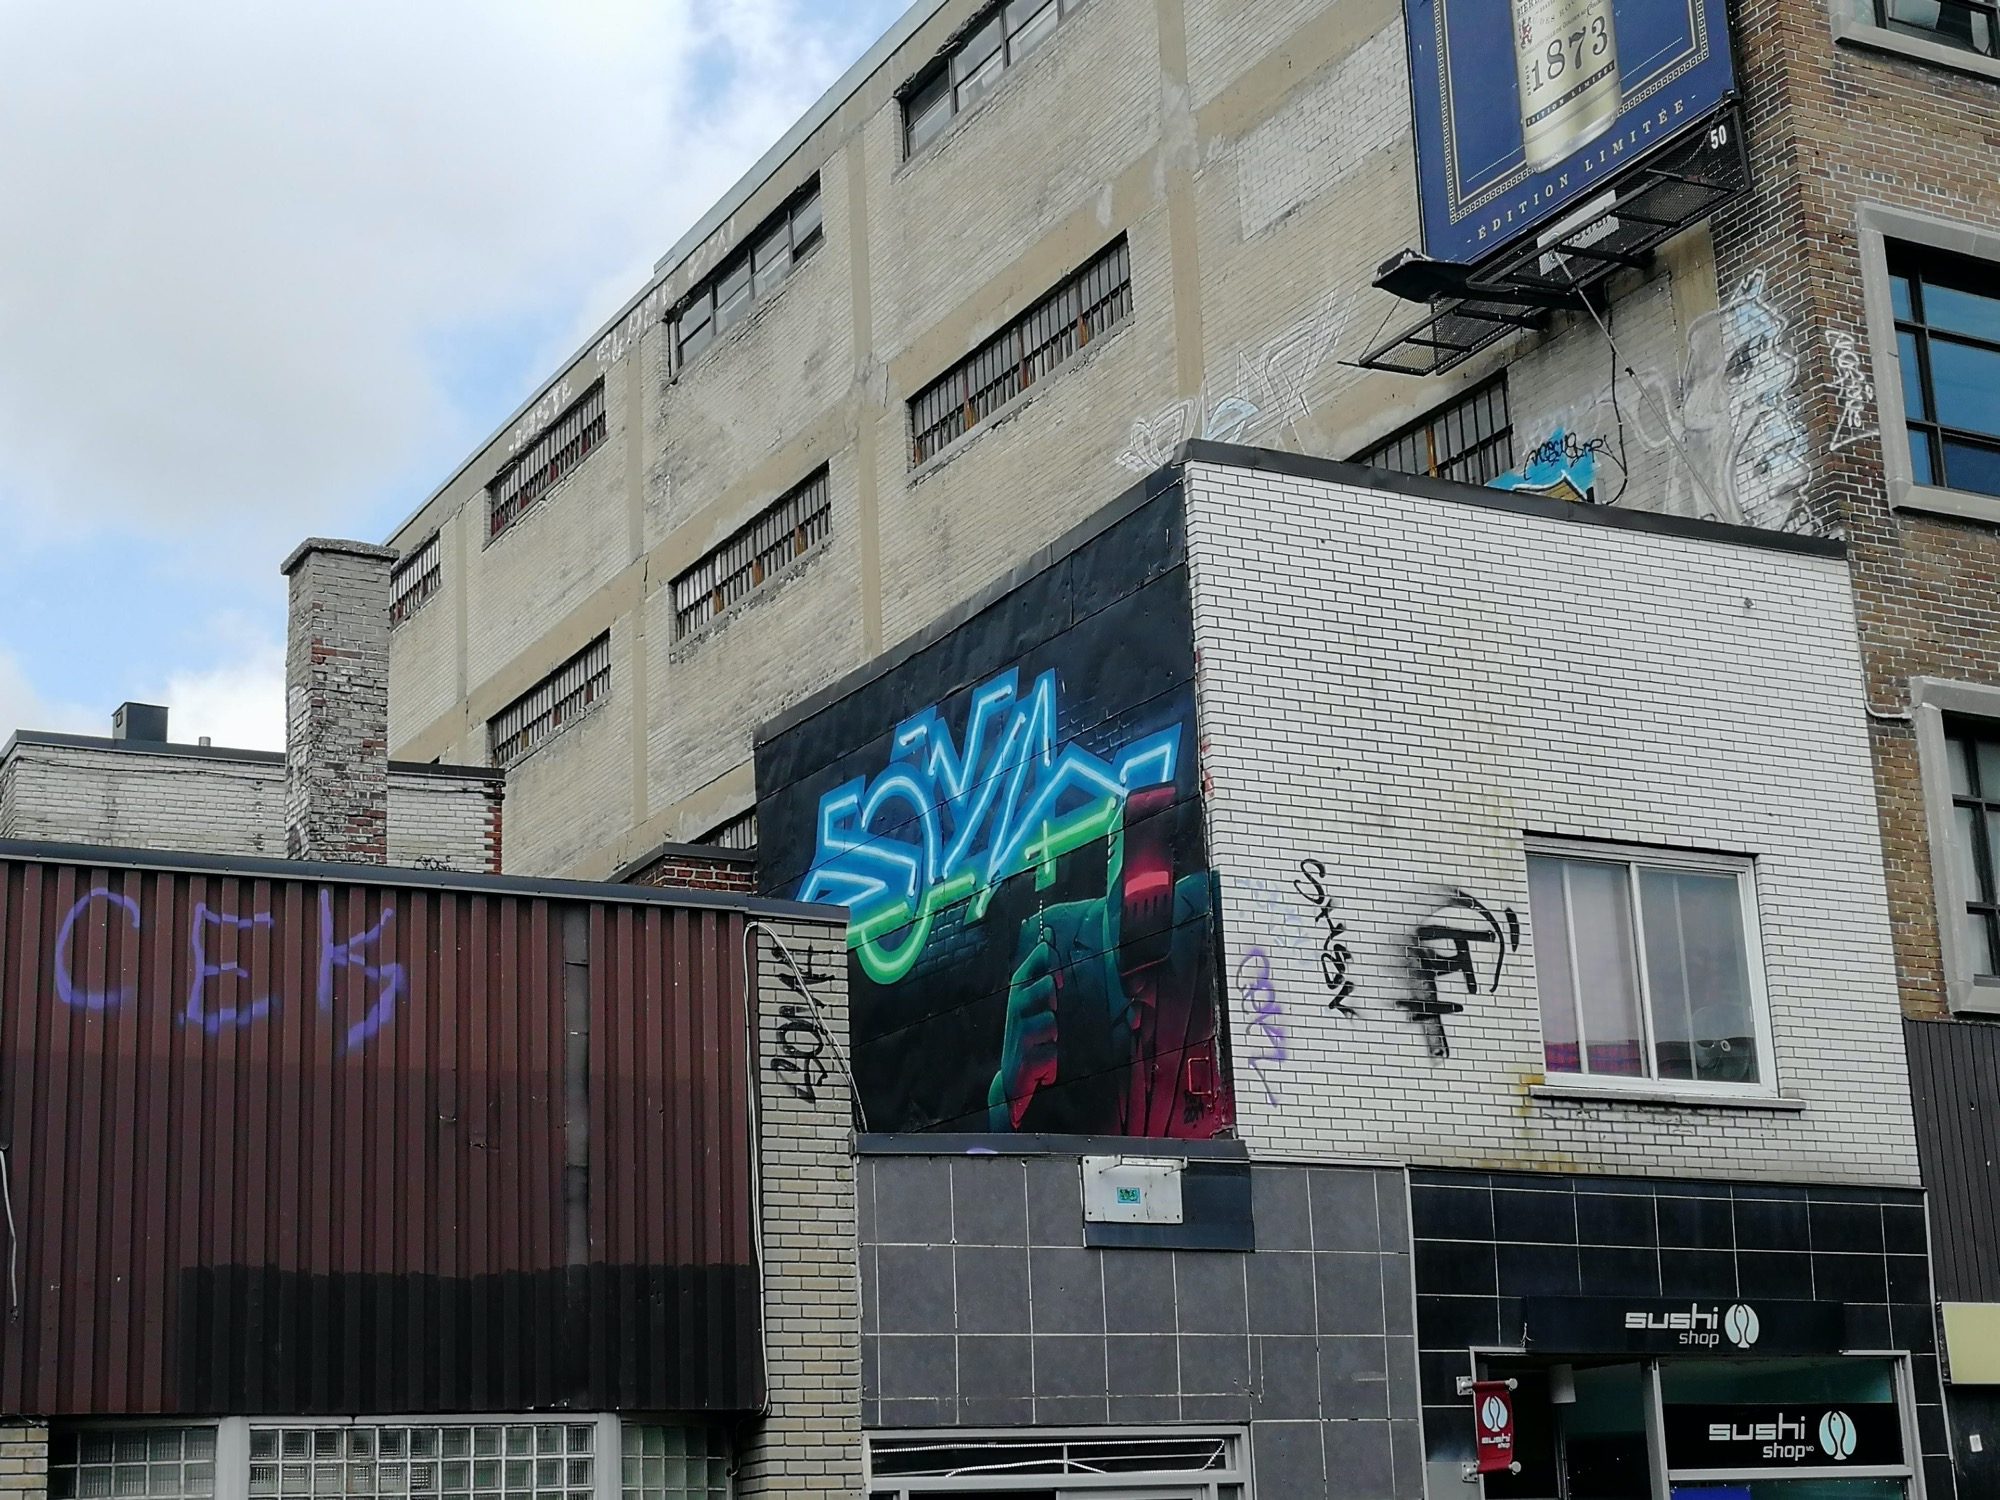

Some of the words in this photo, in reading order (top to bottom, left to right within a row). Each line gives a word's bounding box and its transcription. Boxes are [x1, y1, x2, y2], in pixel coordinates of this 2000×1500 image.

[1531, 15, 1608, 92] 1873
[1711, 125, 1727, 149] 50
[1478, 173, 1569, 240] ÉDITION
[1584, 98, 1684, 172] LIMITÉE
[1625, 1303, 1719, 1330] sushi
[1679, 1330, 1720, 1349] shop
[1481, 1432, 1511, 1445] sushi
[1708, 1412, 1806, 1441] sushi
[1762, 1442, 1806, 1462] shop
